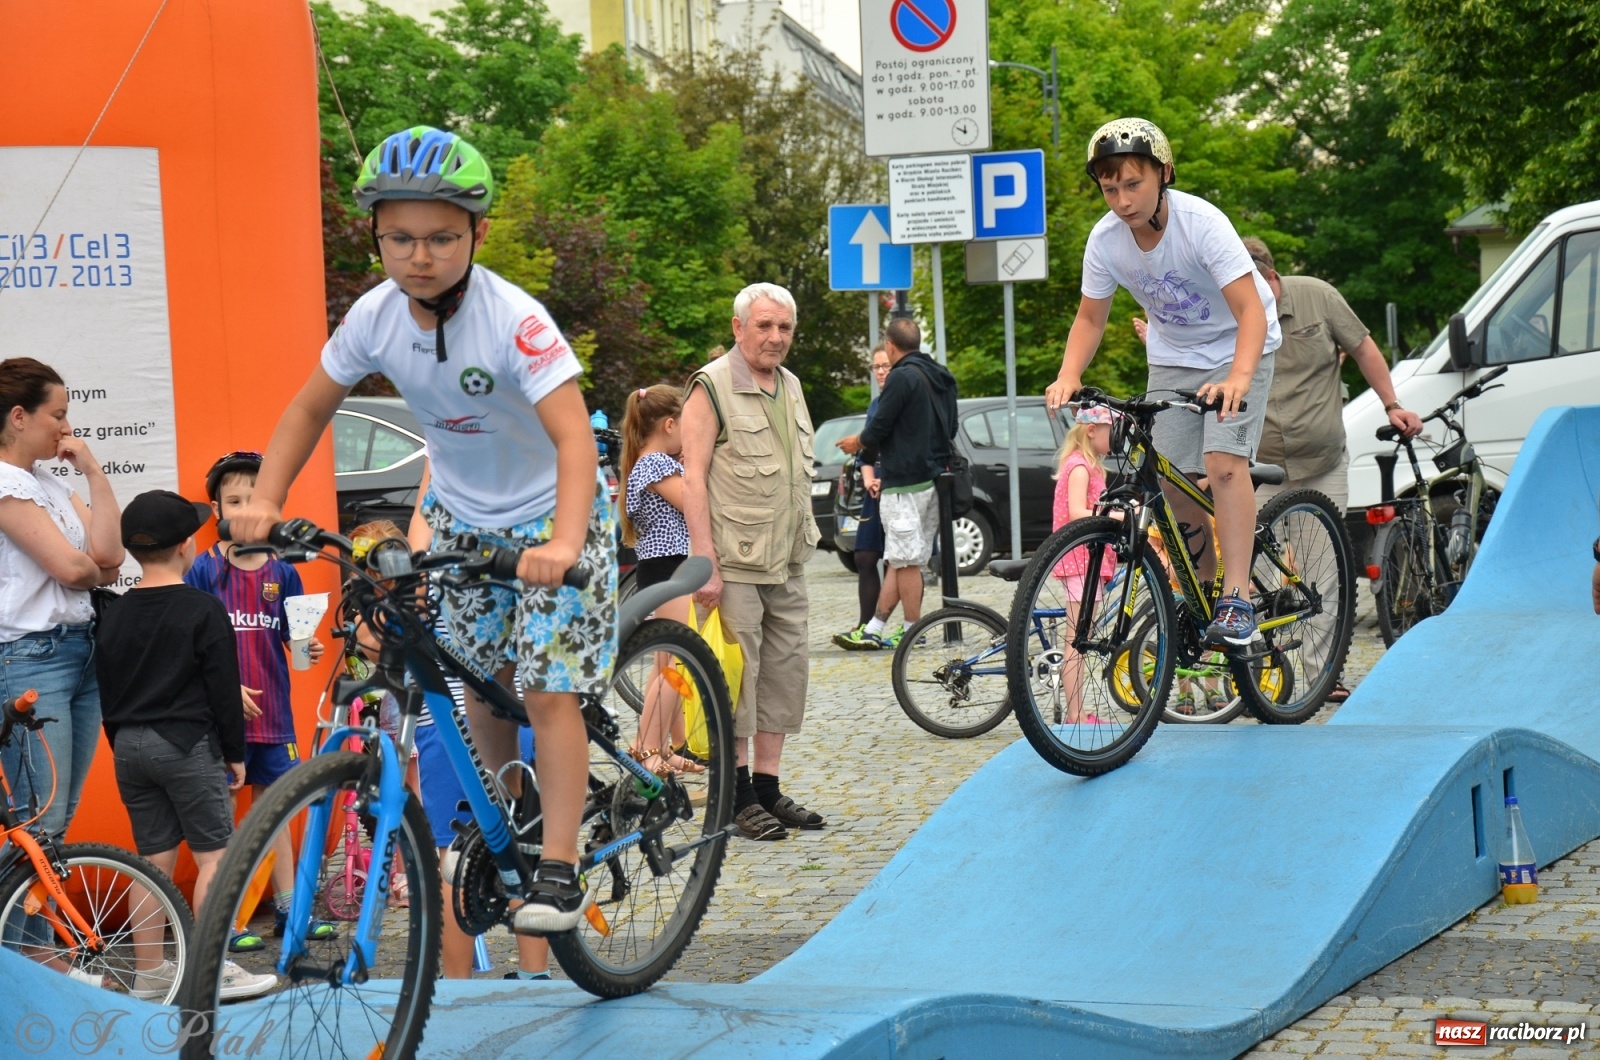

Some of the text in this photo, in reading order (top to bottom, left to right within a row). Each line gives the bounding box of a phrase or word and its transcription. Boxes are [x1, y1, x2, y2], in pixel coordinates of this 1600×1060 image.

[912, 56, 974, 69] ograniczony
[872, 74, 884, 82] do
[888, 73, 892, 81] 1
[896, 72, 924, 83] godz.
[888, 85, 916, 96] godz.
[908, 96, 944, 106] sobota
[888, 110, 916, 122] godz.
[981, 161, 1028, 228] P
[66, 387, 106, 403] jnym
[72, 427, 92, 438] ez
[228, 609, 280, 630] akuten
